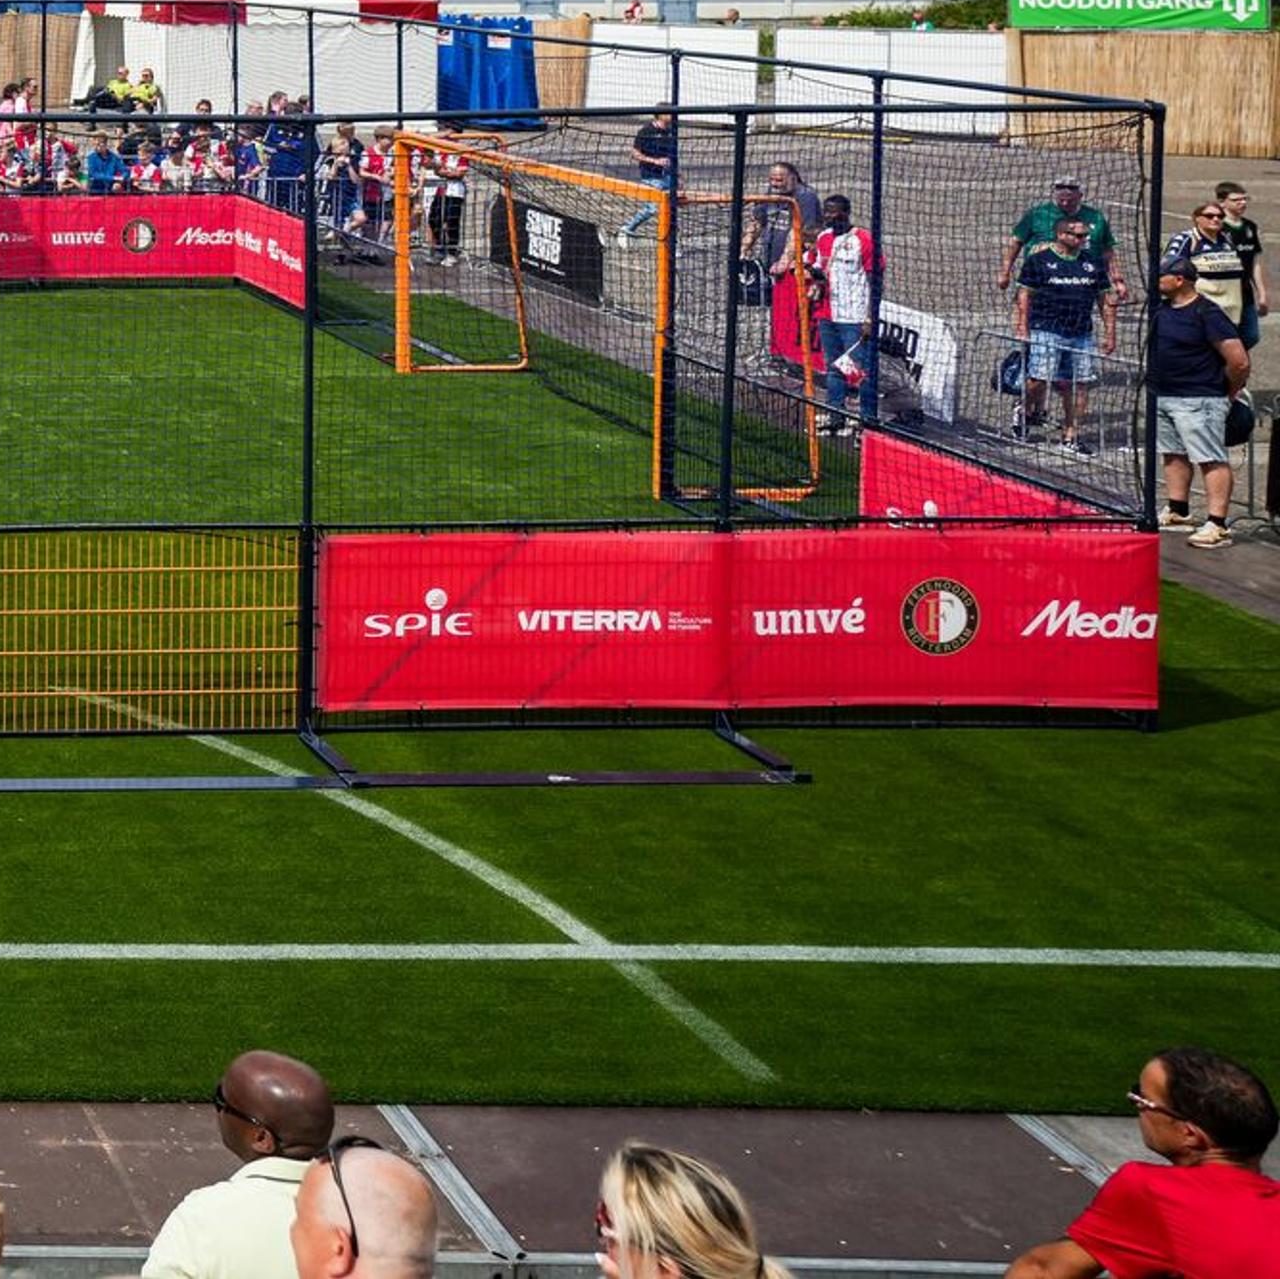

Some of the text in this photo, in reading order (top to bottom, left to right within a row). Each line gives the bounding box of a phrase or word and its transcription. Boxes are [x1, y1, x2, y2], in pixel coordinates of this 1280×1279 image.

[51, 227, 106, 245] univé
[907, 581, 973, 607] FEYENOORD
[518, 610, 662, 632] VITERRA
[753, 597, 866, 636] univé
[907, 628, 974, 653] ROTTERDAM
